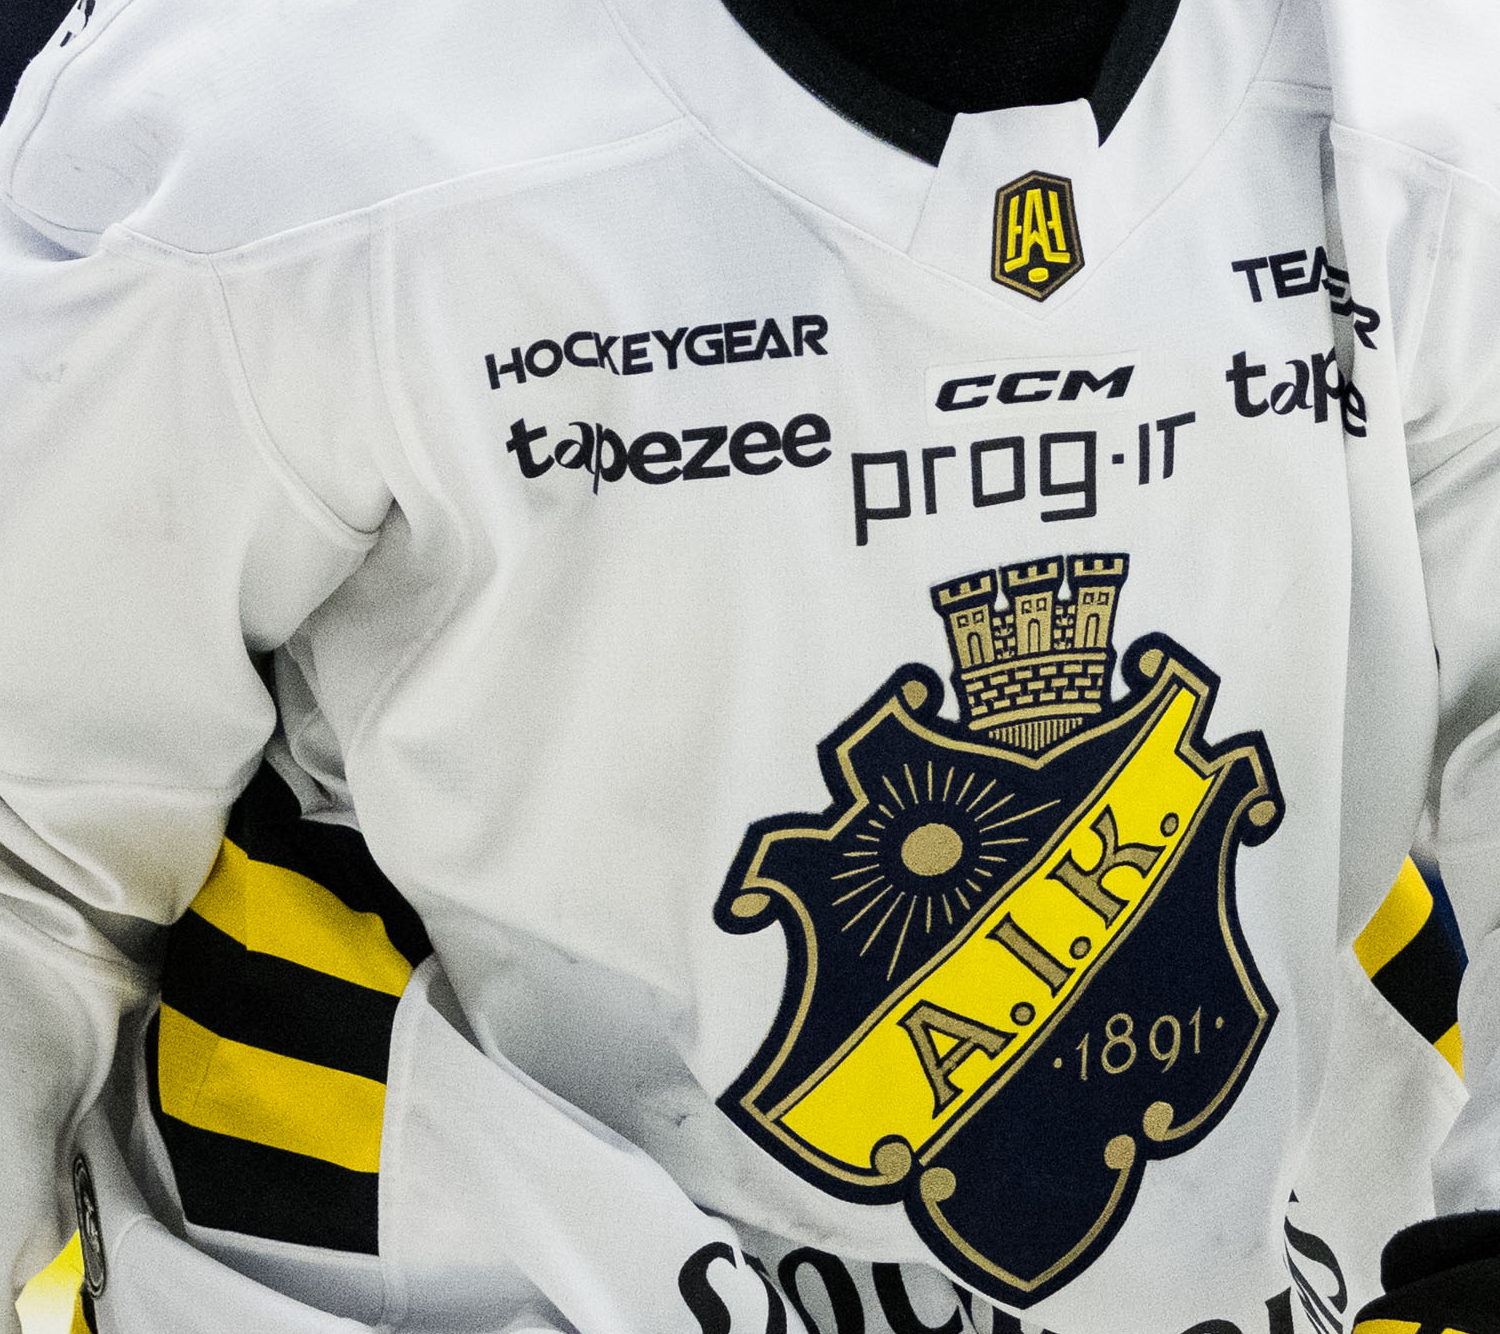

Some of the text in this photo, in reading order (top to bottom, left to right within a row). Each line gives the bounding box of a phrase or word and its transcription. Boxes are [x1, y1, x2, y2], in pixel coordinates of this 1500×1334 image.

[484, 314, 829, 390] HOCKEYGEAR
[934, 365, 1137, 413] CCM
[505, 411, 832, 495] tapezee
[899, 803, 1182, 1118] A.I.K.
